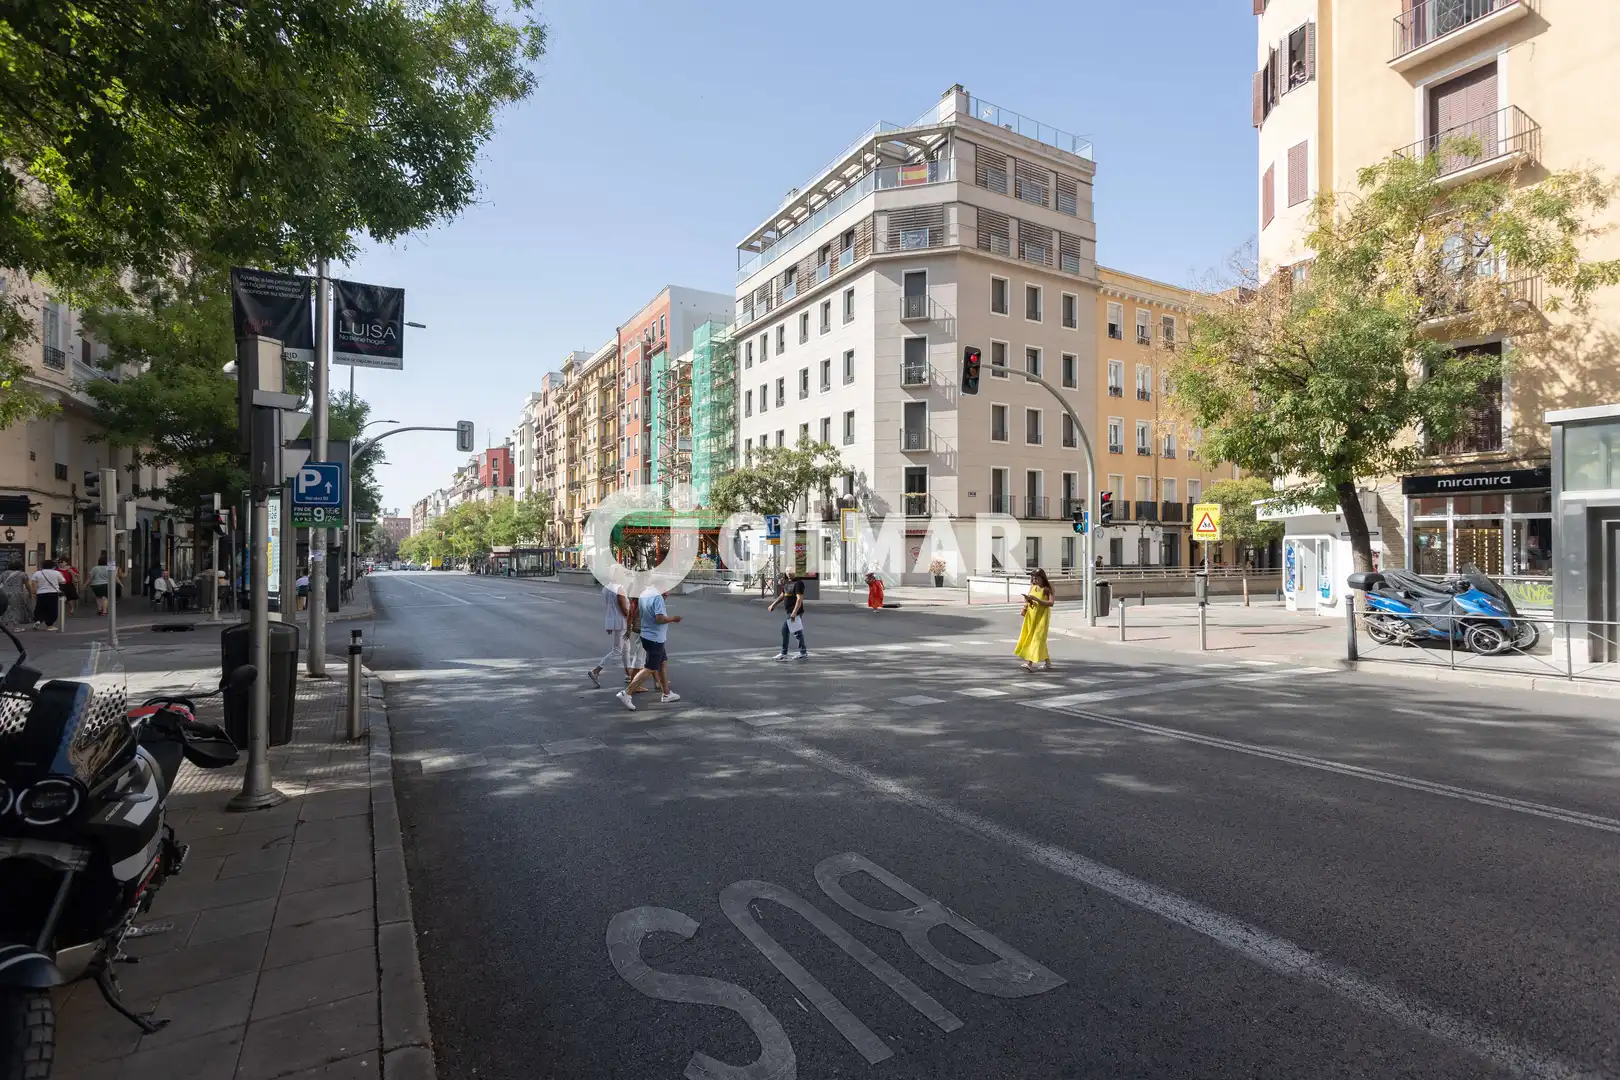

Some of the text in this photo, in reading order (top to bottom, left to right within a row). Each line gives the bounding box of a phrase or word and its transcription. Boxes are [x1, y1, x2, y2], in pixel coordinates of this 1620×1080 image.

[339, 320, 396, 339] LUISA
[349, 335, 365, 343] tiene
[299, 469, 322, 494] P
[1437, 475, 1512, 488] miramira
[605, 851, 1068, 1080] BUS
